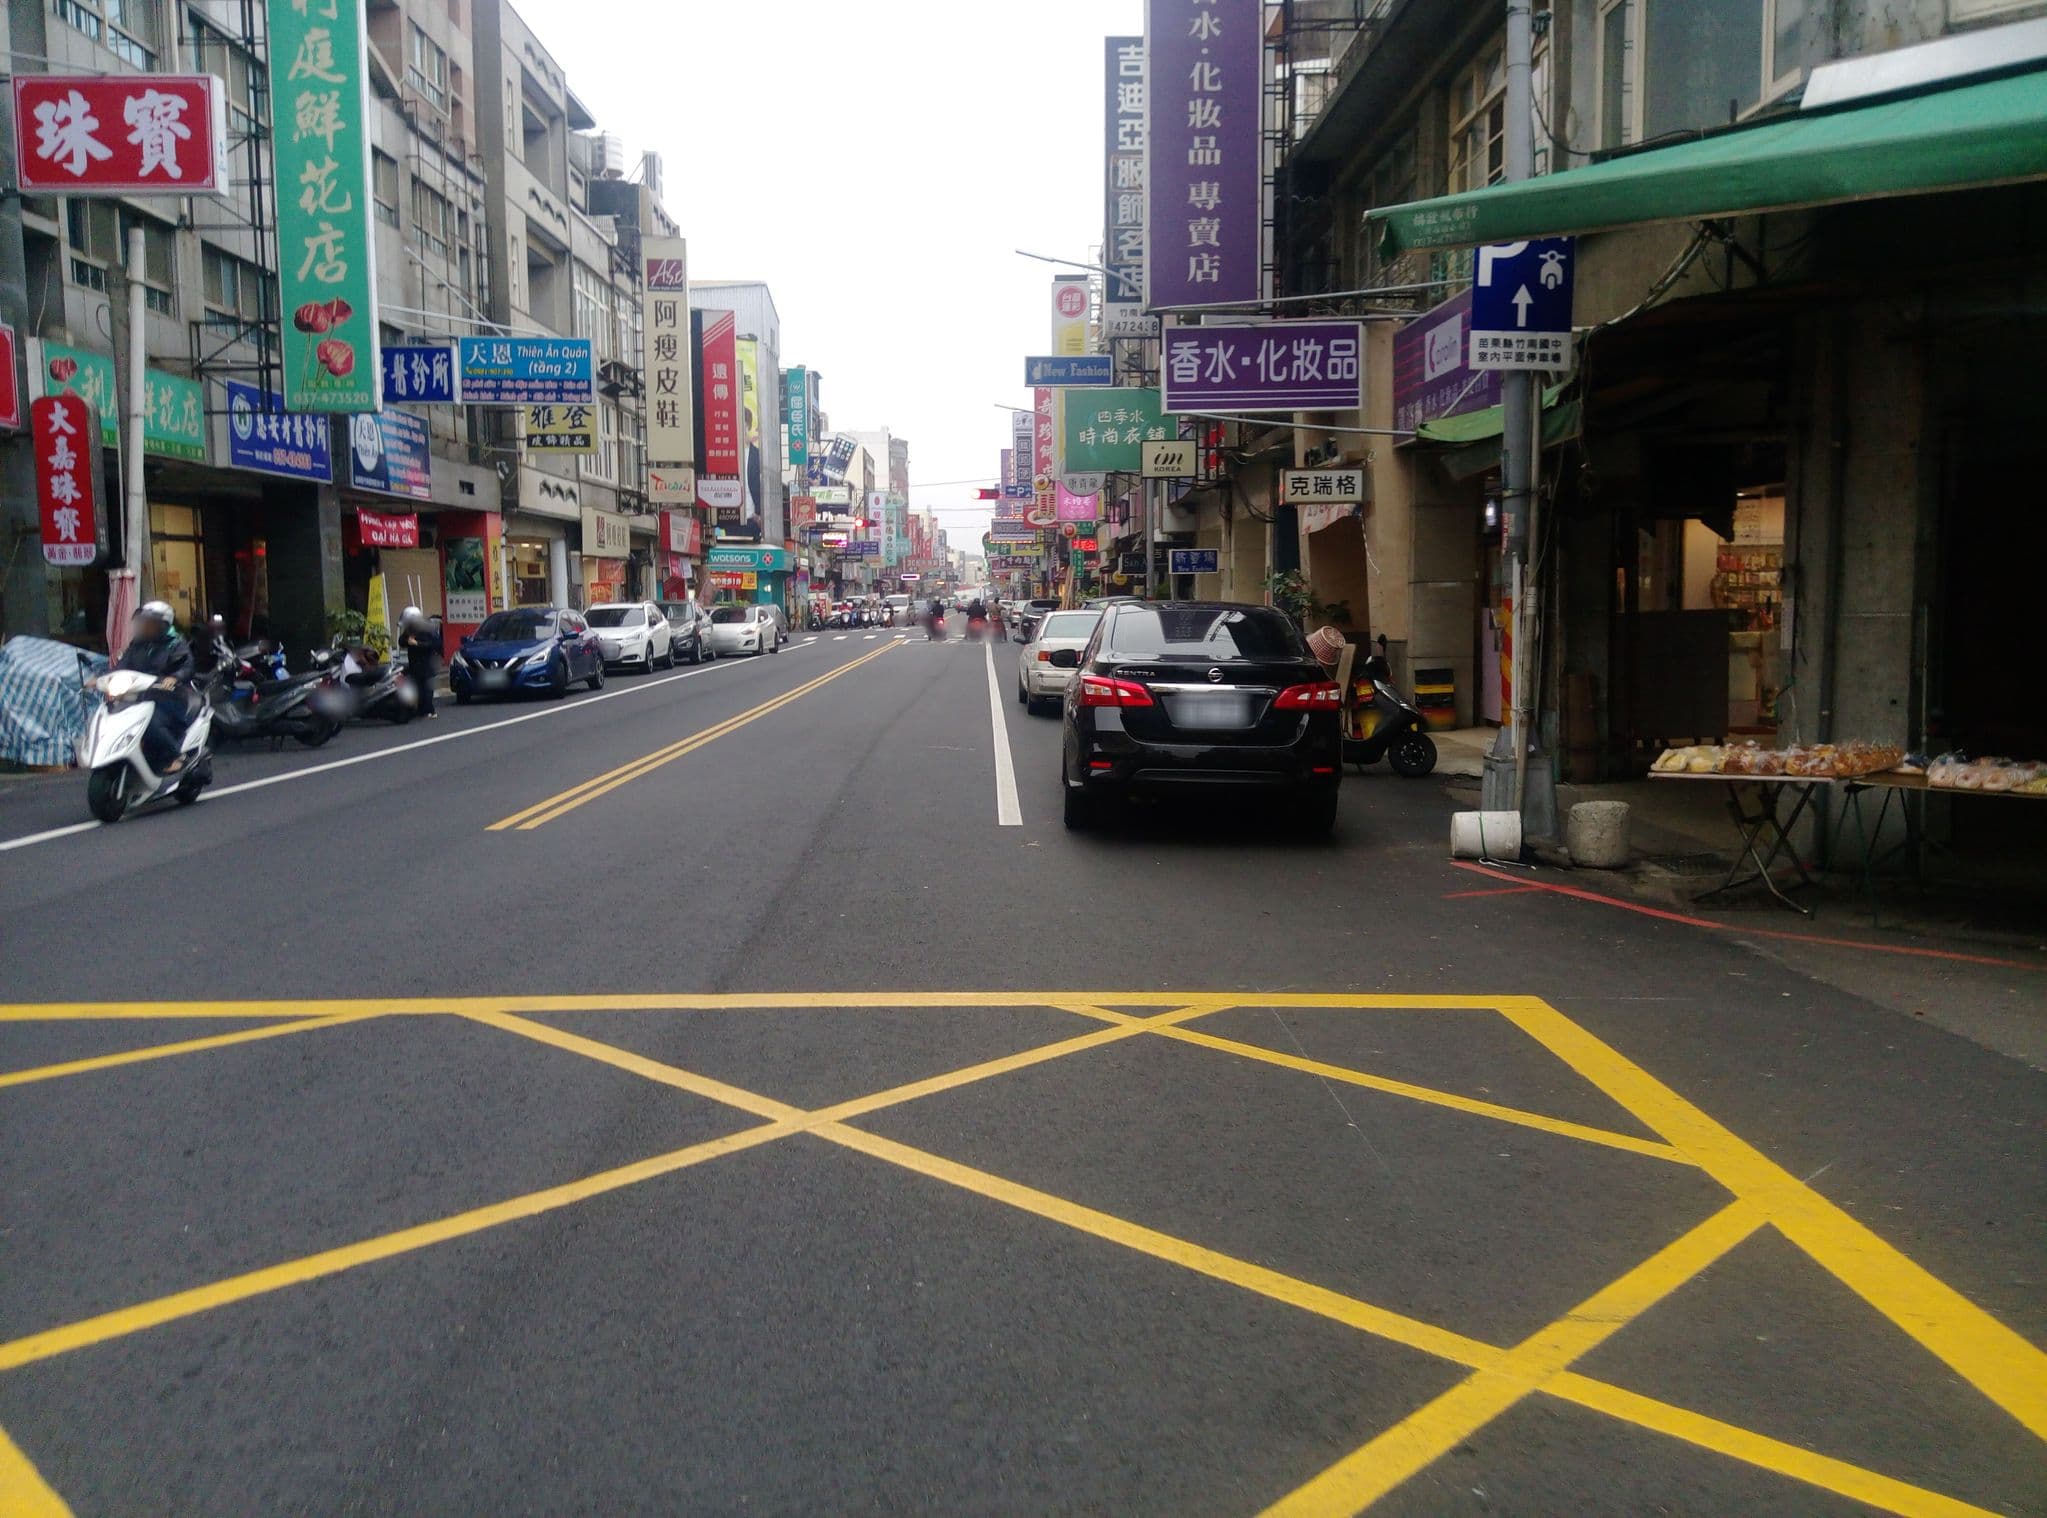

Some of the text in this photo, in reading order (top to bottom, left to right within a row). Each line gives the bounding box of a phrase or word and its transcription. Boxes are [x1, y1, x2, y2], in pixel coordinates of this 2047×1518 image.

[33, 88, 192, 180] 珠寶
[1187, 0, 1223, 283] 水·化妝品專賣店
[468, 342, 513, 365] 天恩
[1478, 338, 1562, 349] 苗栗縣竹南國中
[654, 300, 680, 429] 阿瘦皮鞋
[1169, 338, 1358, 384] 香水·化妝品
[1478, 352, 1561, 363] 室內平面停車場
[1070, 362, 1109, 376] Fashion
[1098, 408, 1144, 423] 四季水
[48, 401, 82, 542] 大嘉珠寶
[1290, 475, 1356, 496] 克瑞格
[710, 554, 751, 563] watsons
[1117, 669, 1156, 677] SENTRA
